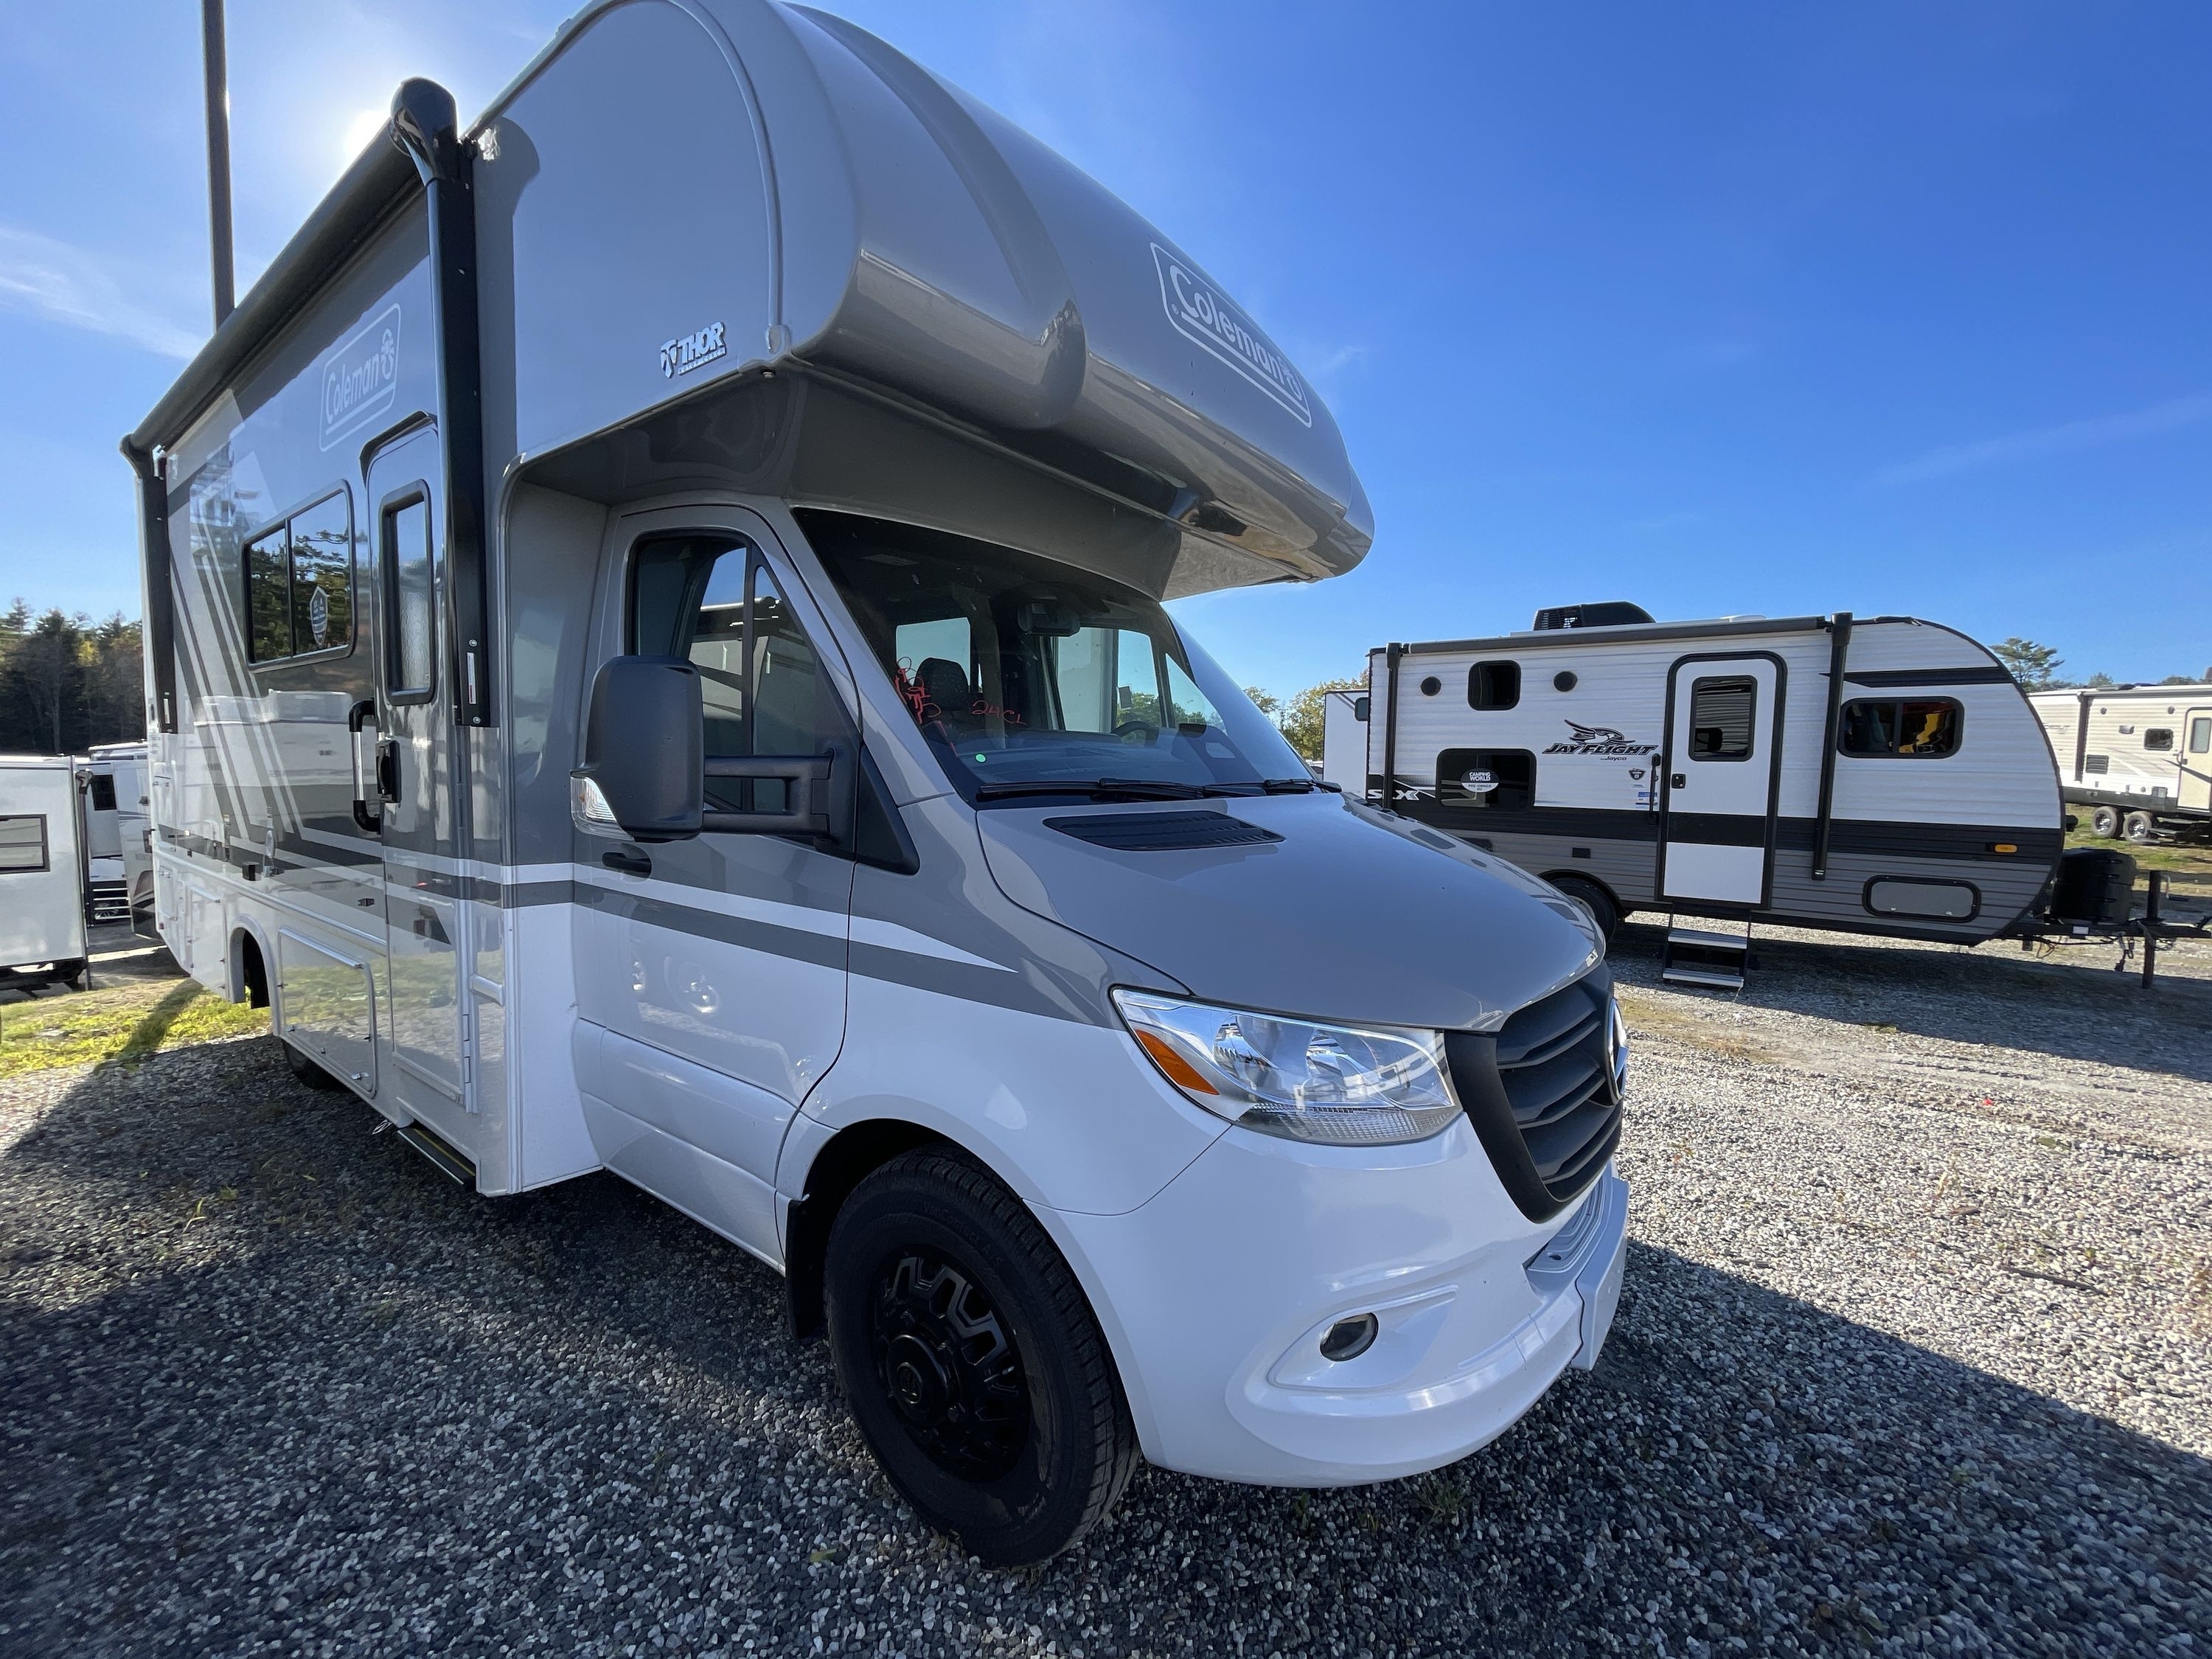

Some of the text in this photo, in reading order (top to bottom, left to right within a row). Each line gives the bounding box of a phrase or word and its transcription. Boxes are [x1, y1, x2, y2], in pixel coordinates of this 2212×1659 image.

[678, 321, 726, 365] THOR
[1169, 264, 1285, 386] Coleman
[325, 352, 380, 425] Coleman
[1542, 742, 1659, 756] JAY FLIGHT
